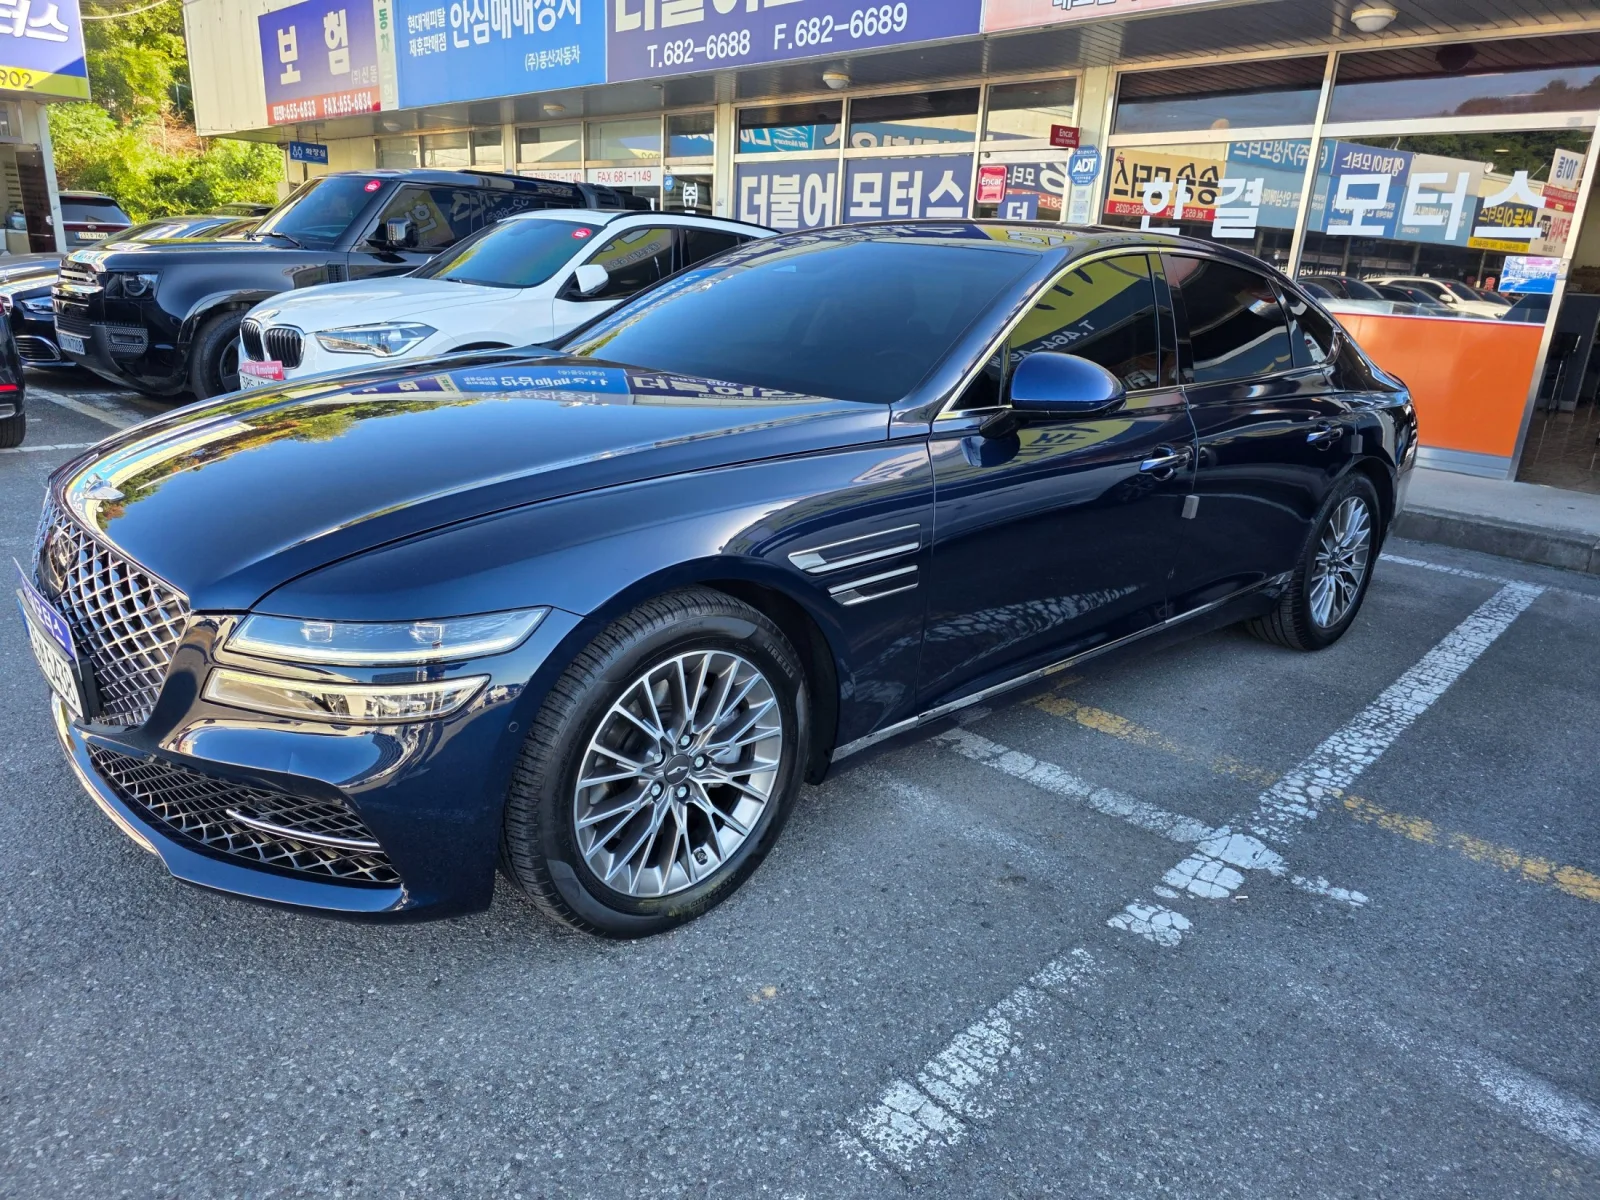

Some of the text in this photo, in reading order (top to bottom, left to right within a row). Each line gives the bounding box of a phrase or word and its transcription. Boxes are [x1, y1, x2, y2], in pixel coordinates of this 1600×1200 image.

[773, 2, 908, 50] F.682-6689
[647, 29, 751, 68] T.682-6688
[597, 172, 611, 182] FAX
[614, 170, 652, 183] 681-1149
[981, 175, 1003, 186] Encar
[1072, 157, 1097, 173] ADT
[740, 170, 965, 230] 더불어 모터스
[1326, 170, 1546, 241] 모터스
